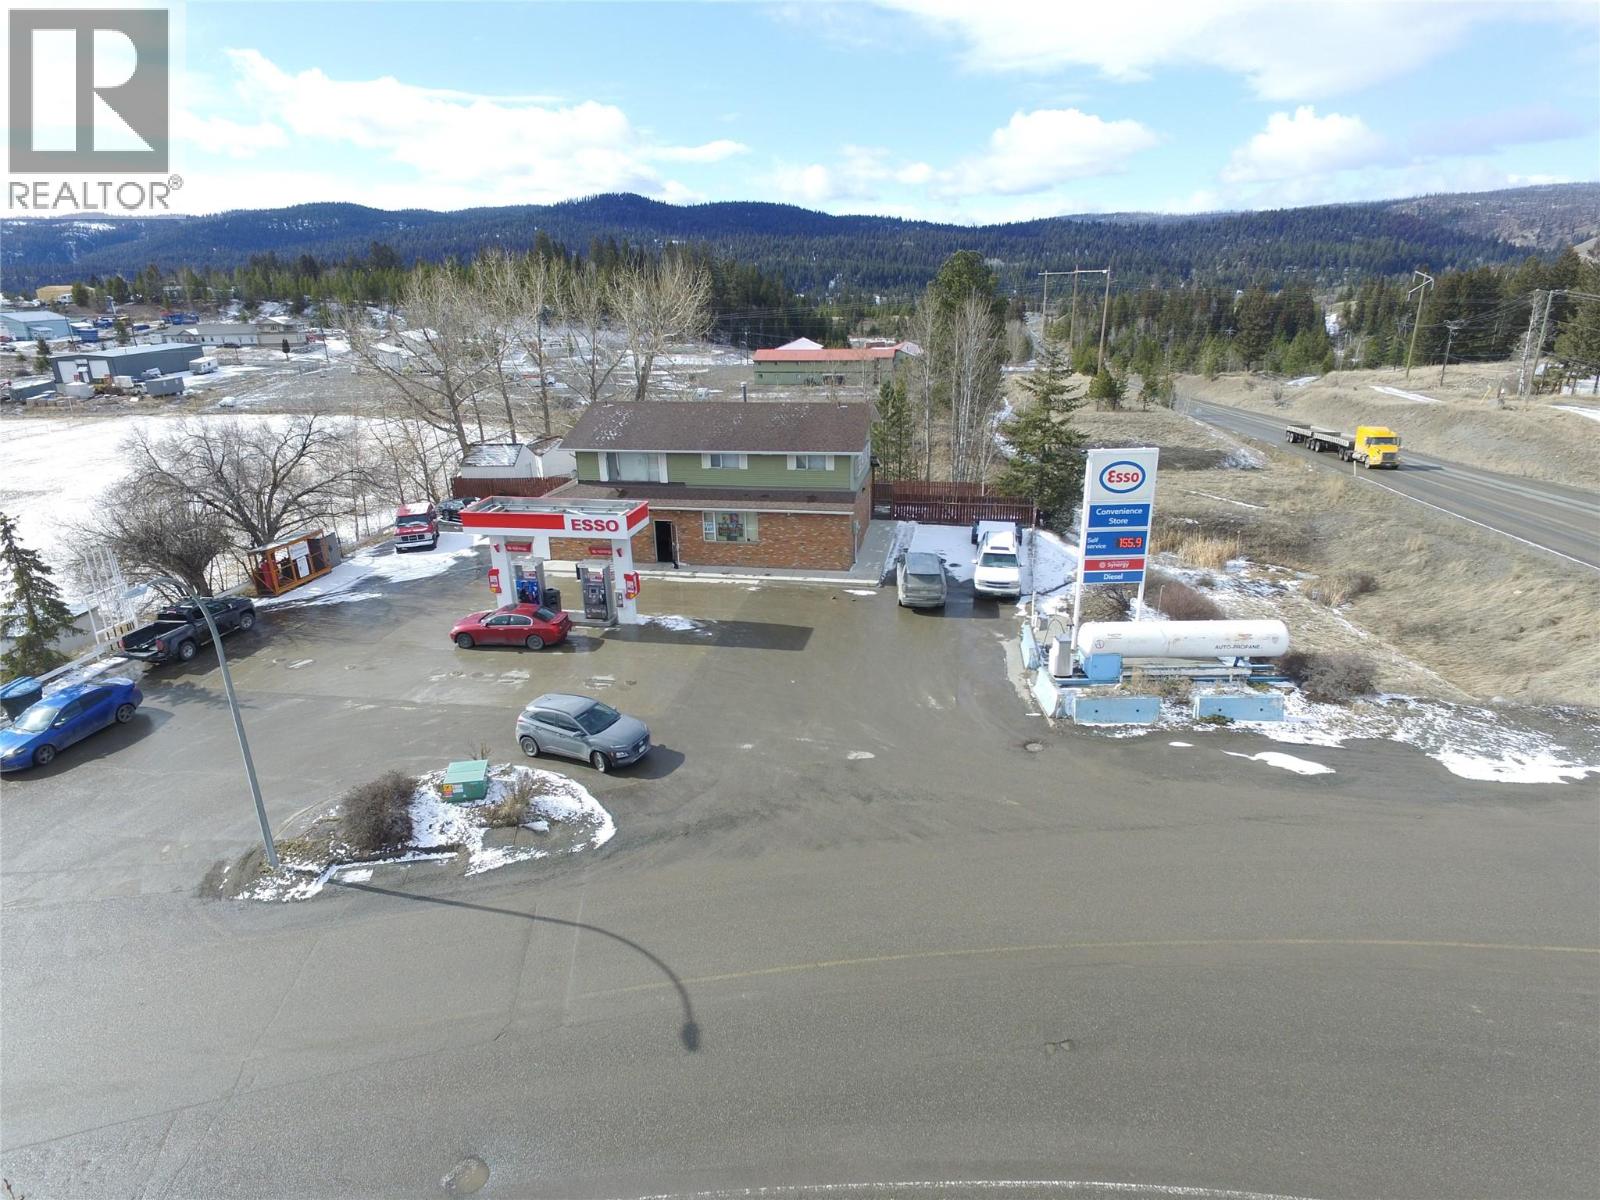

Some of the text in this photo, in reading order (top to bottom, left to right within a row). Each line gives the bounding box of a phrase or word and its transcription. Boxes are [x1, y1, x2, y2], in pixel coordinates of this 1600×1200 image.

[1107, 470, 1139, 483] Esso
[1096, 507, 1143, 516] Convenience
[571, 519, 619, 532] ESSO
[1108, 517, 1129, 525] Store
[1119, 537, 1142, 548] 155.9
[1103, 573, 1124, 581] Diesel
